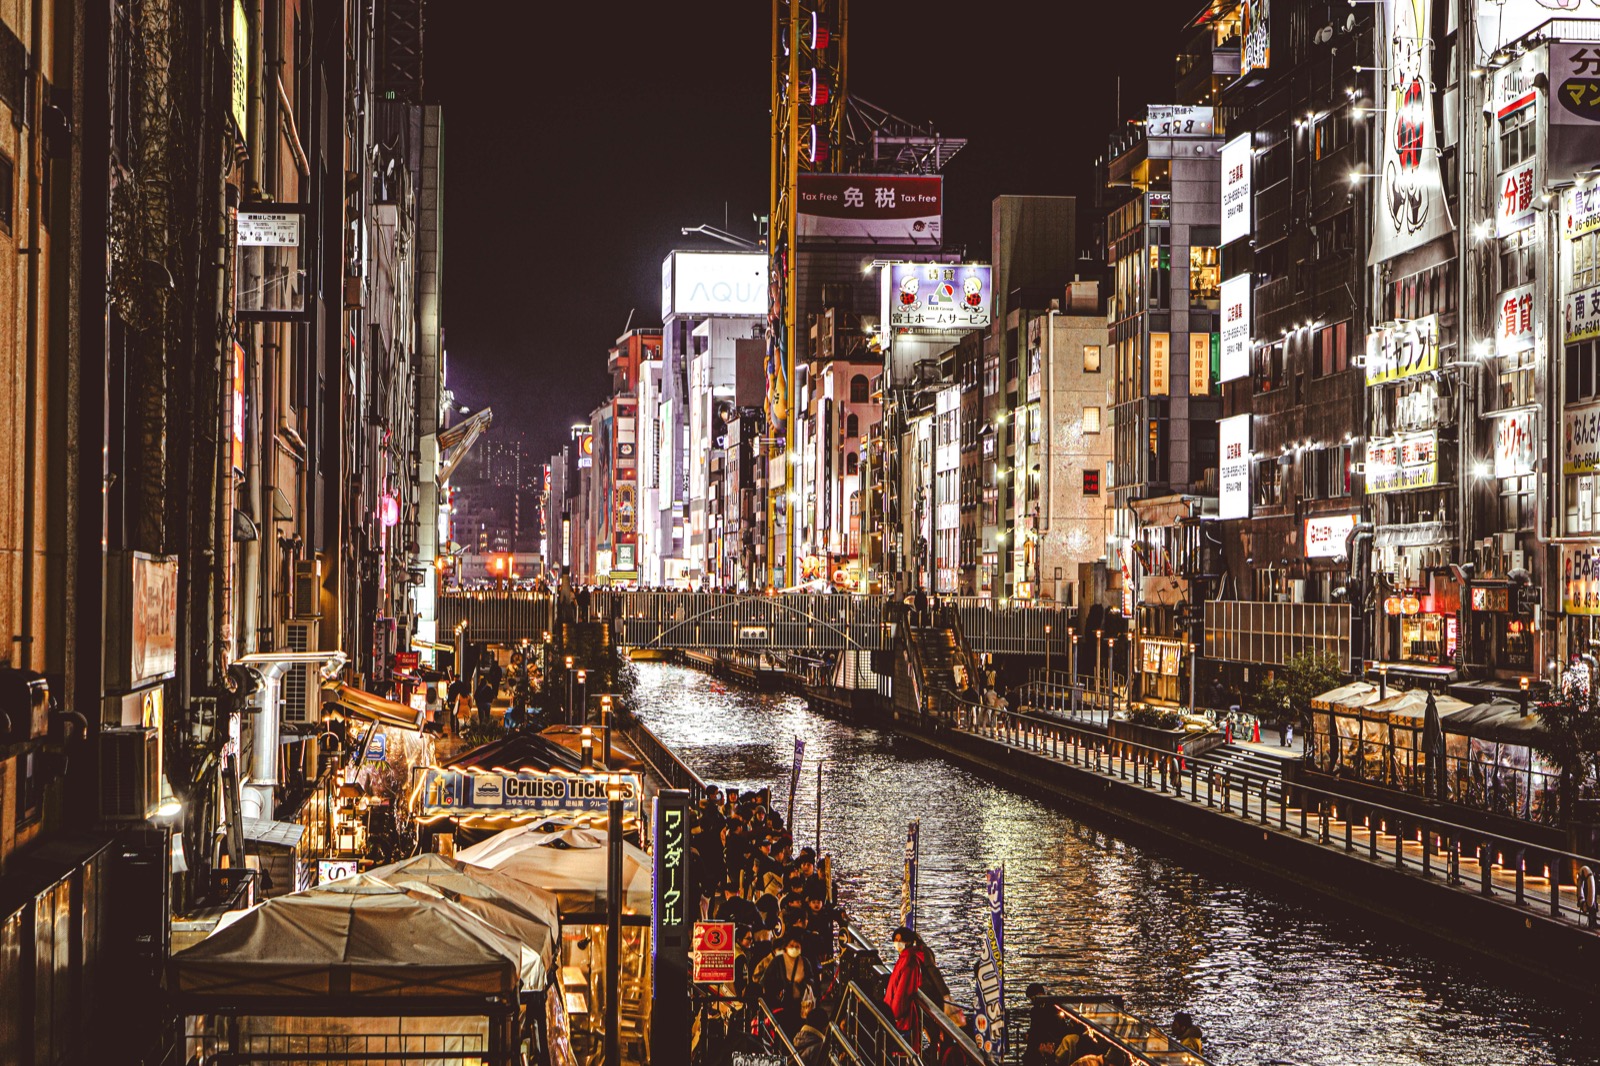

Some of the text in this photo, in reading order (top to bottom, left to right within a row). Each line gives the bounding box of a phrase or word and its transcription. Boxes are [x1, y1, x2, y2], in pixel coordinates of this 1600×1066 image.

[802, 192, 839, 201] Tax Free
[901, 194, 937, 203] Tax Free
[1504, 168, 1533, 217] 分譲
[892, 312, 990, 325] 富士ホームサービス
[1503, 292, 1533, 339] 賃貸
[506, 777, 633, 799] Cruise Ticks
[711, 931, 721, 945] 3
